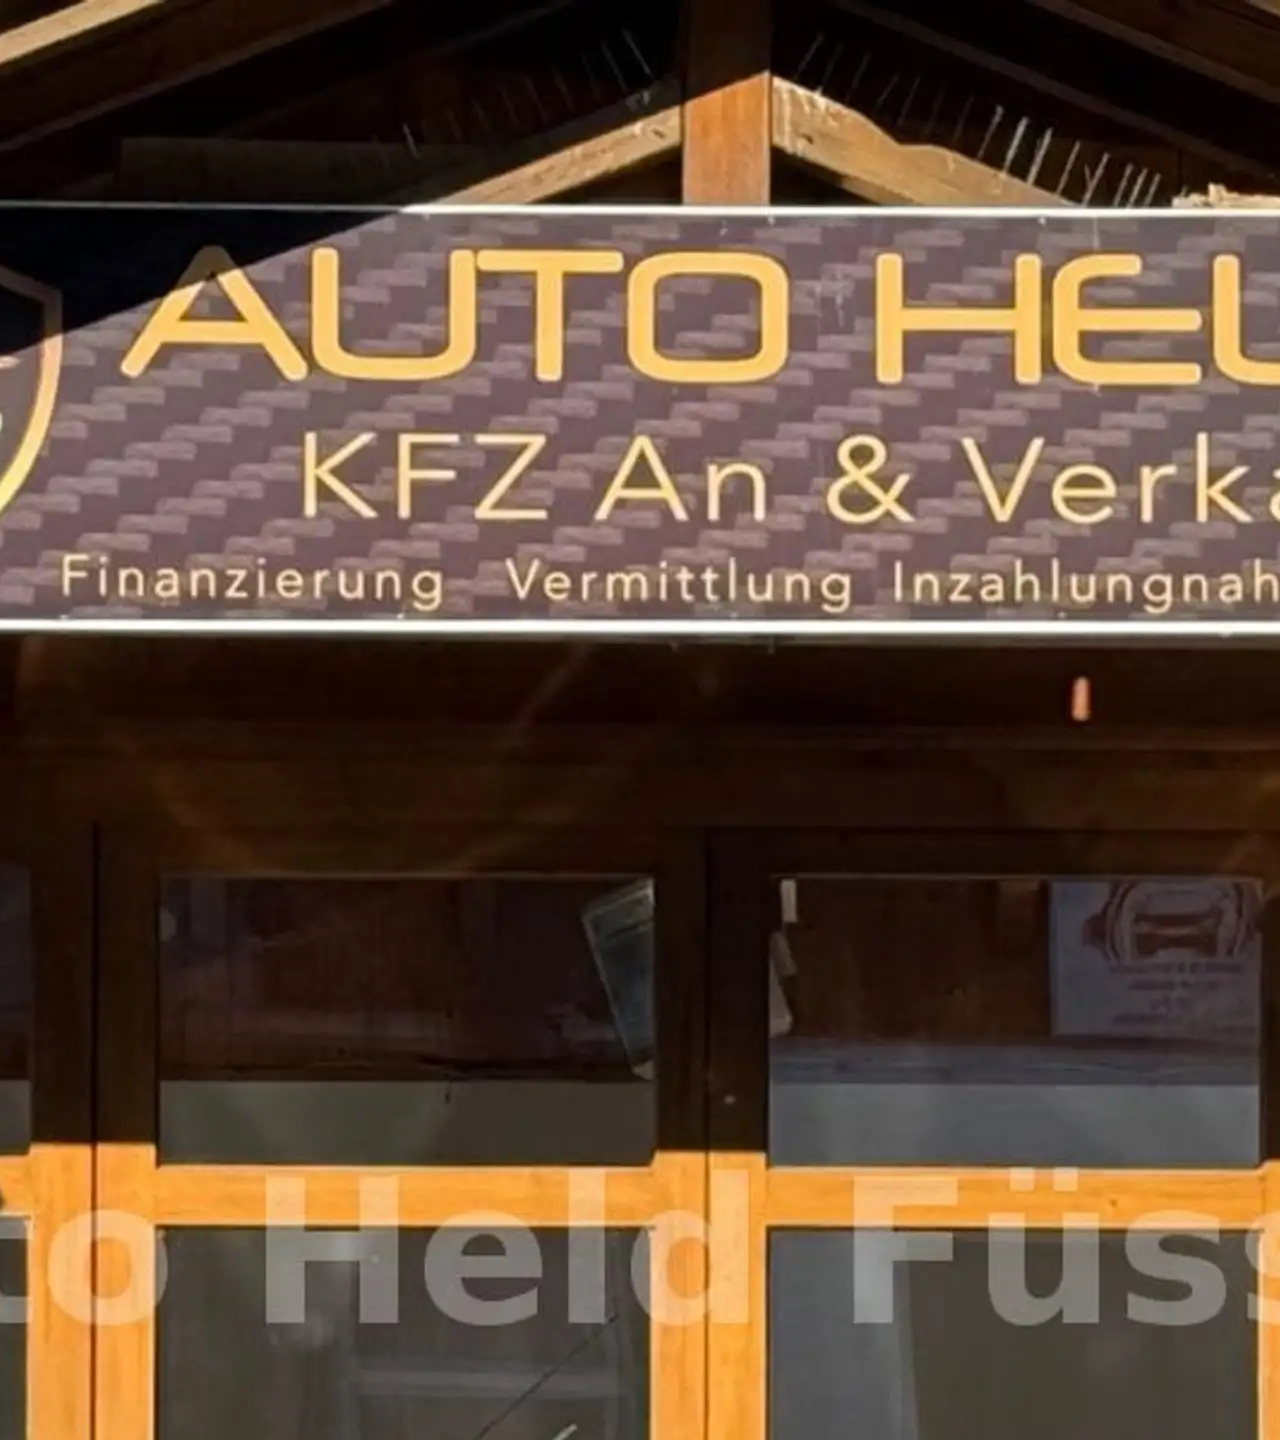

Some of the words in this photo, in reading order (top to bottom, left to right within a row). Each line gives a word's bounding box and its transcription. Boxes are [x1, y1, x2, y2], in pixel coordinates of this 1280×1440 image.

[120, 245, 790, 387] AUTO
[301, 432, 551, 521] KFZ
[593, 434, 768, 524] An
[823, 432, 917, 525] &
[61, 553, 444, 613] Finanzierung
[504, 555, 853, 615] Vermittlung
